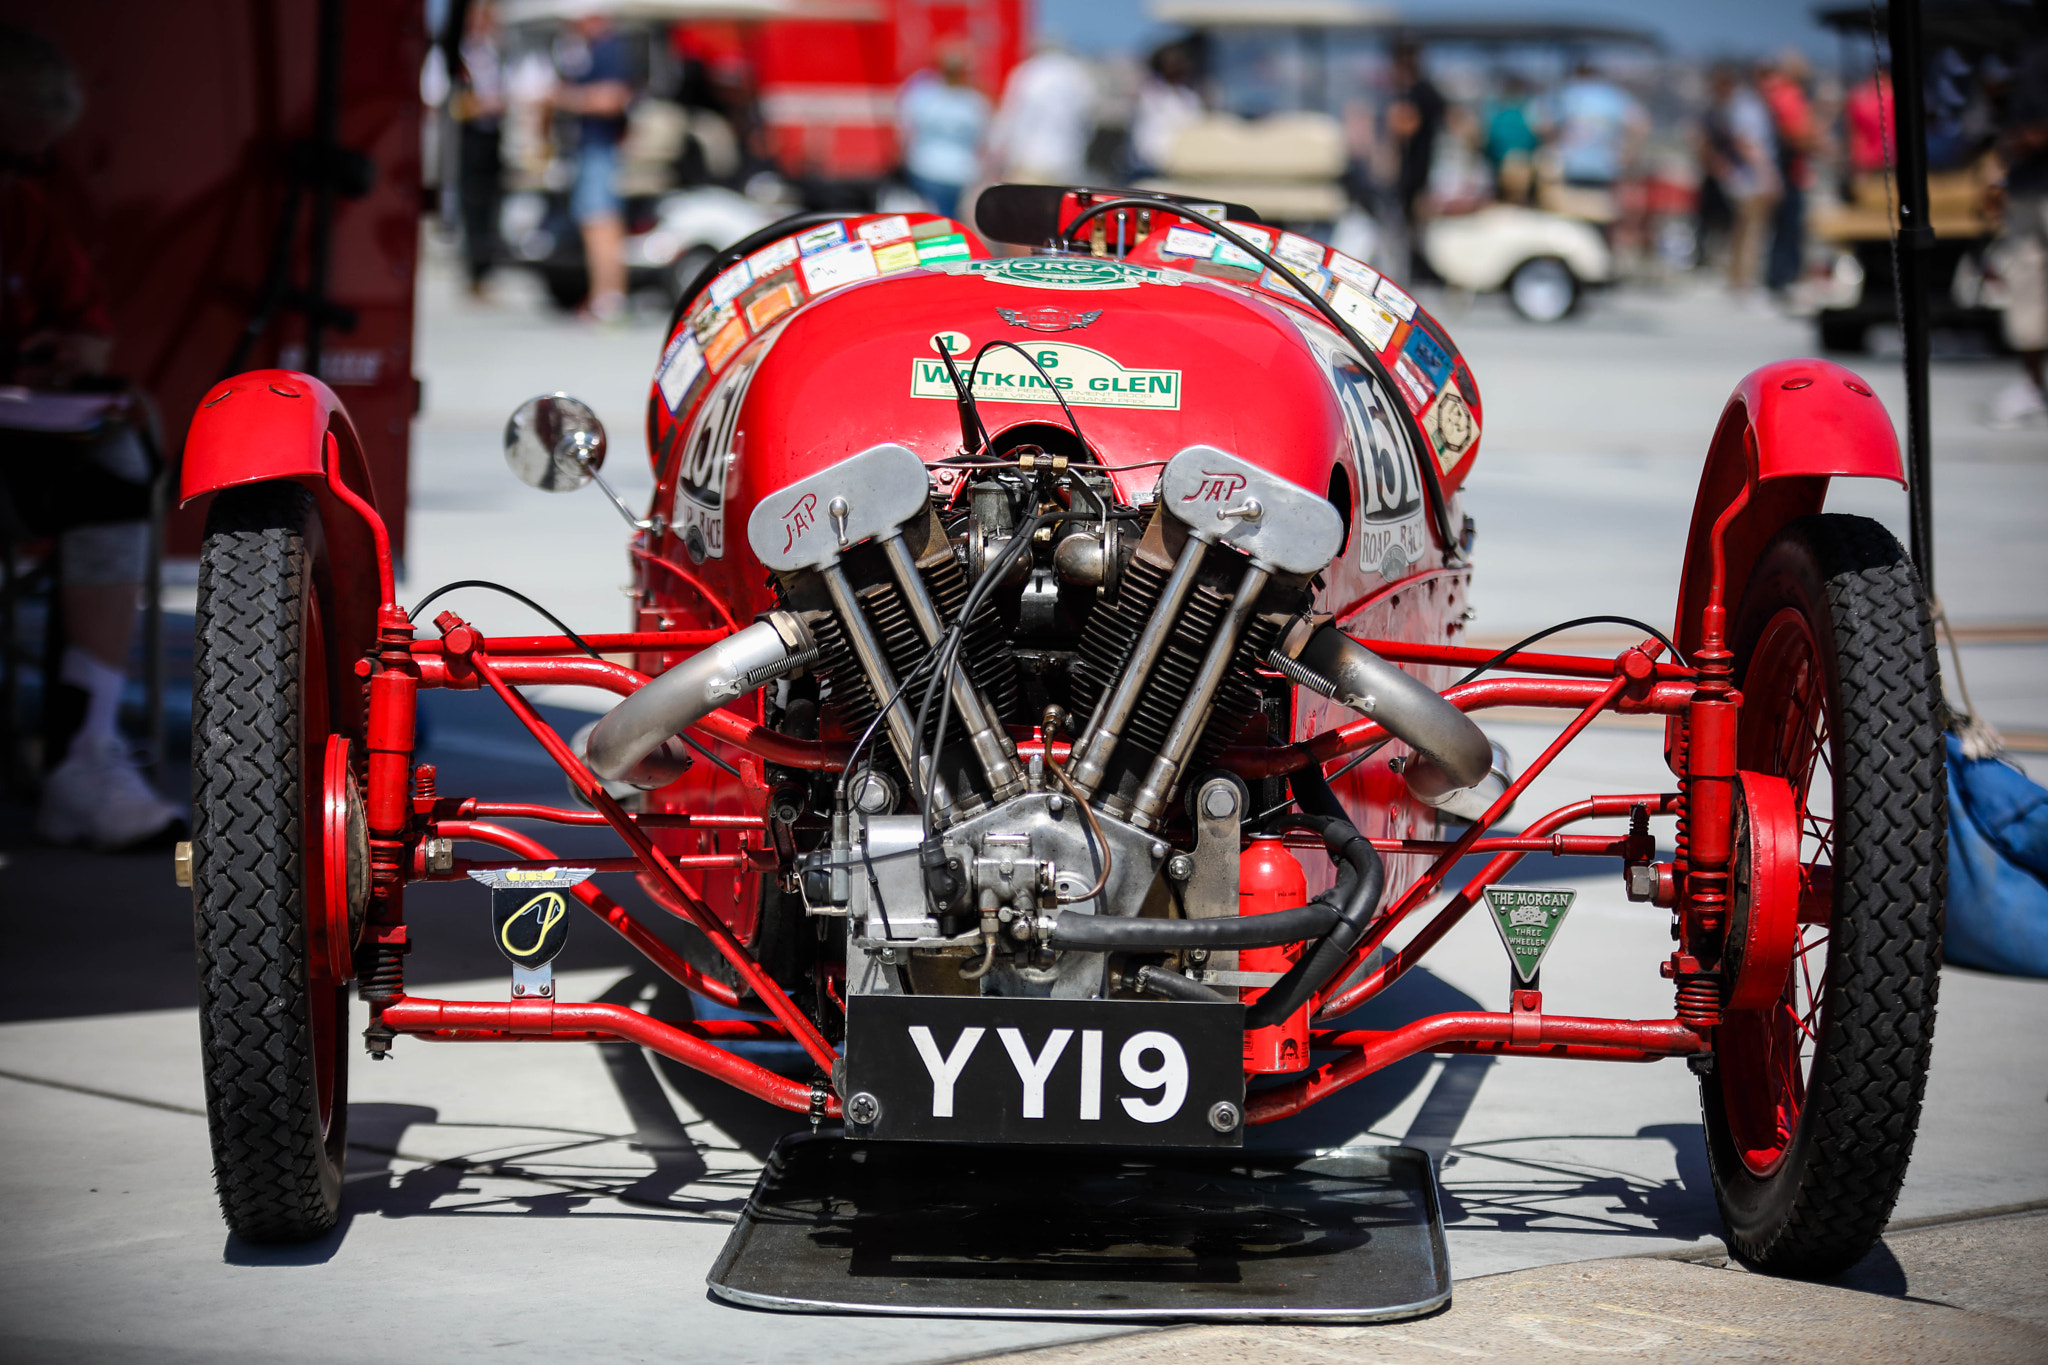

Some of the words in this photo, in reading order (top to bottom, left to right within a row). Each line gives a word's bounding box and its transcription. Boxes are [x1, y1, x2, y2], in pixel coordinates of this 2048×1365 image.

[979, 262, 1148, 277] MORGAN
[1018, 313, 1078, 322] MORGAN
[940, 334, 959, 352] 1
[1036, 350, 1059, 369] 6
[922, 364, 1074, 390] WATKINS
[1088, 375, 1173, 394] GLEN
[1342, 376, 1420, 516] 151
[1492, 892, 1514, 906] THE
[1516, 892, 1570, 907] MORGAN
[1514, 928, 1542, 937] THREE
[1508, 937, 1546, 946] WHEELER
[1515, 947, 1539, 956] CLUB
